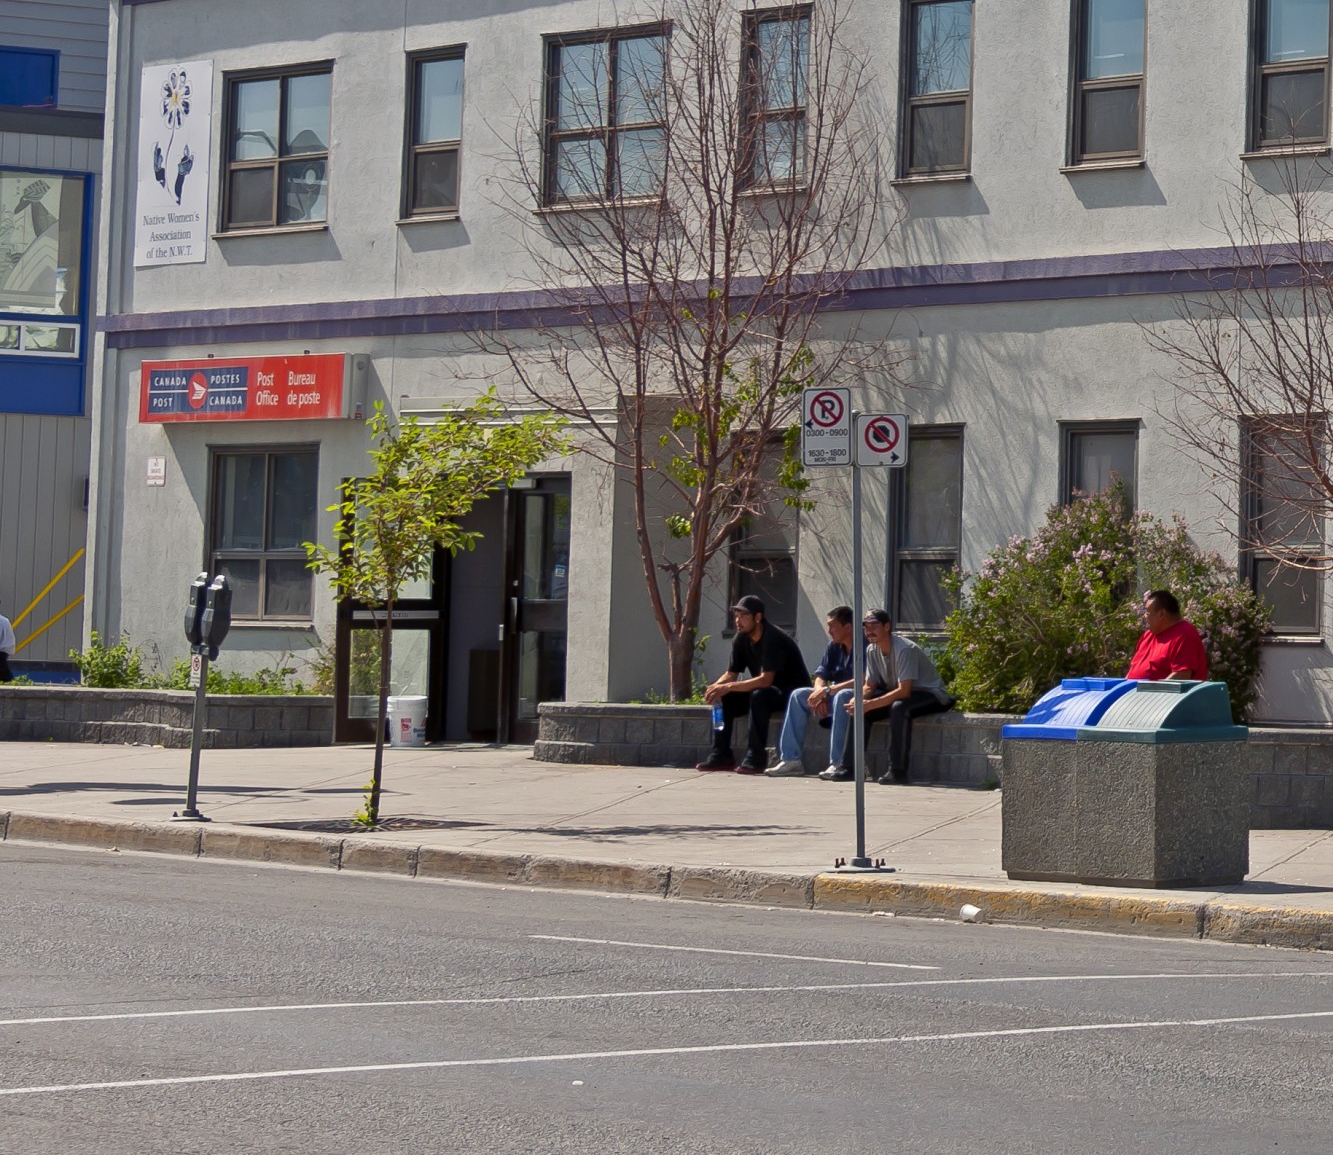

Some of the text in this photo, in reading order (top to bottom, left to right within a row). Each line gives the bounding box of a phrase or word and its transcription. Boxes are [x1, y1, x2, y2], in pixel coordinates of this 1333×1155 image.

[143, 212, 200, 226] Native Women's
[149, 230, 191, 242] Association
[146, 245, 193, 259] of the N.W.T.
[154, 376, 187, 387] CANADA
[210, 374, 240, 384] POSTES
[257, 371, 274, 387] Post
[288, 370, 316, 386] Bureau
[153, 397, 173, 407] POST
[209, 395, 243, 406] CANADA
[256, 391, 278, 406] Office
[287, 390, 321, 409] de poste
